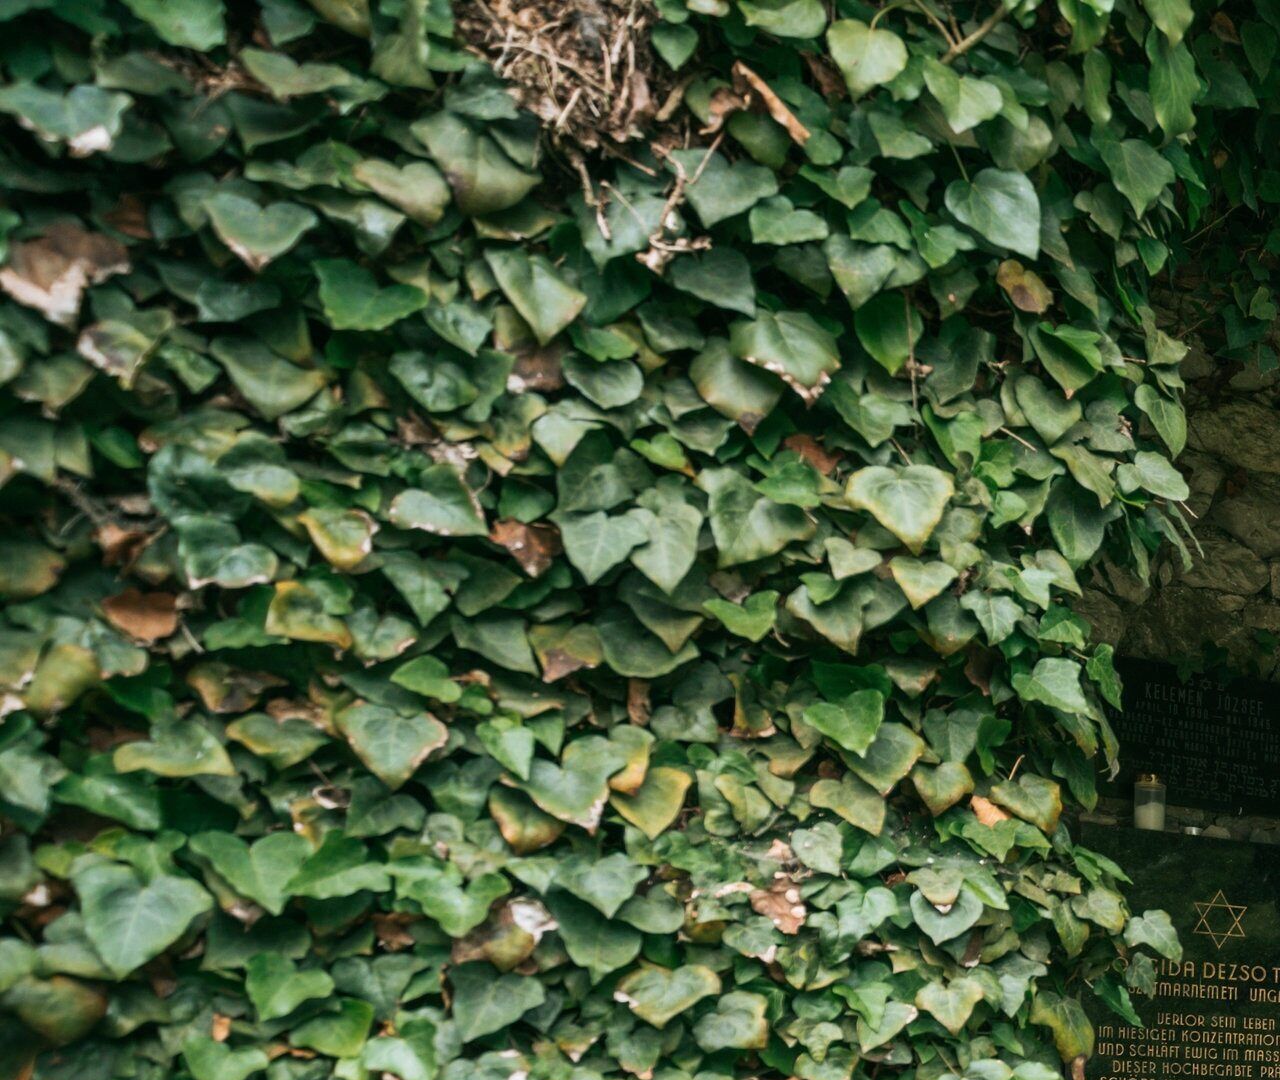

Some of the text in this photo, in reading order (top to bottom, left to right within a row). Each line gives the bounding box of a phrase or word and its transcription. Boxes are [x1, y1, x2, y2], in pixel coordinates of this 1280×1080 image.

[1203, 962, 1266, 982] DEZSO
[1157, 1013, 1275, 1030] VERLOR SEIN LEBEN
[1099, 1026, 1113, 1038] IM
[1119, 1026, 1175, 1041] HIESIGEN
[1099, 1043, 1123, 1056] UND
[1129, 1042, 1179, 1057] SCHLÄFT
[1185, 1047, 1217, 1059] EWIG
[1224, 1048, 1238, 1060] IM
[1113, 1060, 1156, 1074] DIESER
[1163, 1062, 1252, 1077] HOCHBEGABTE
